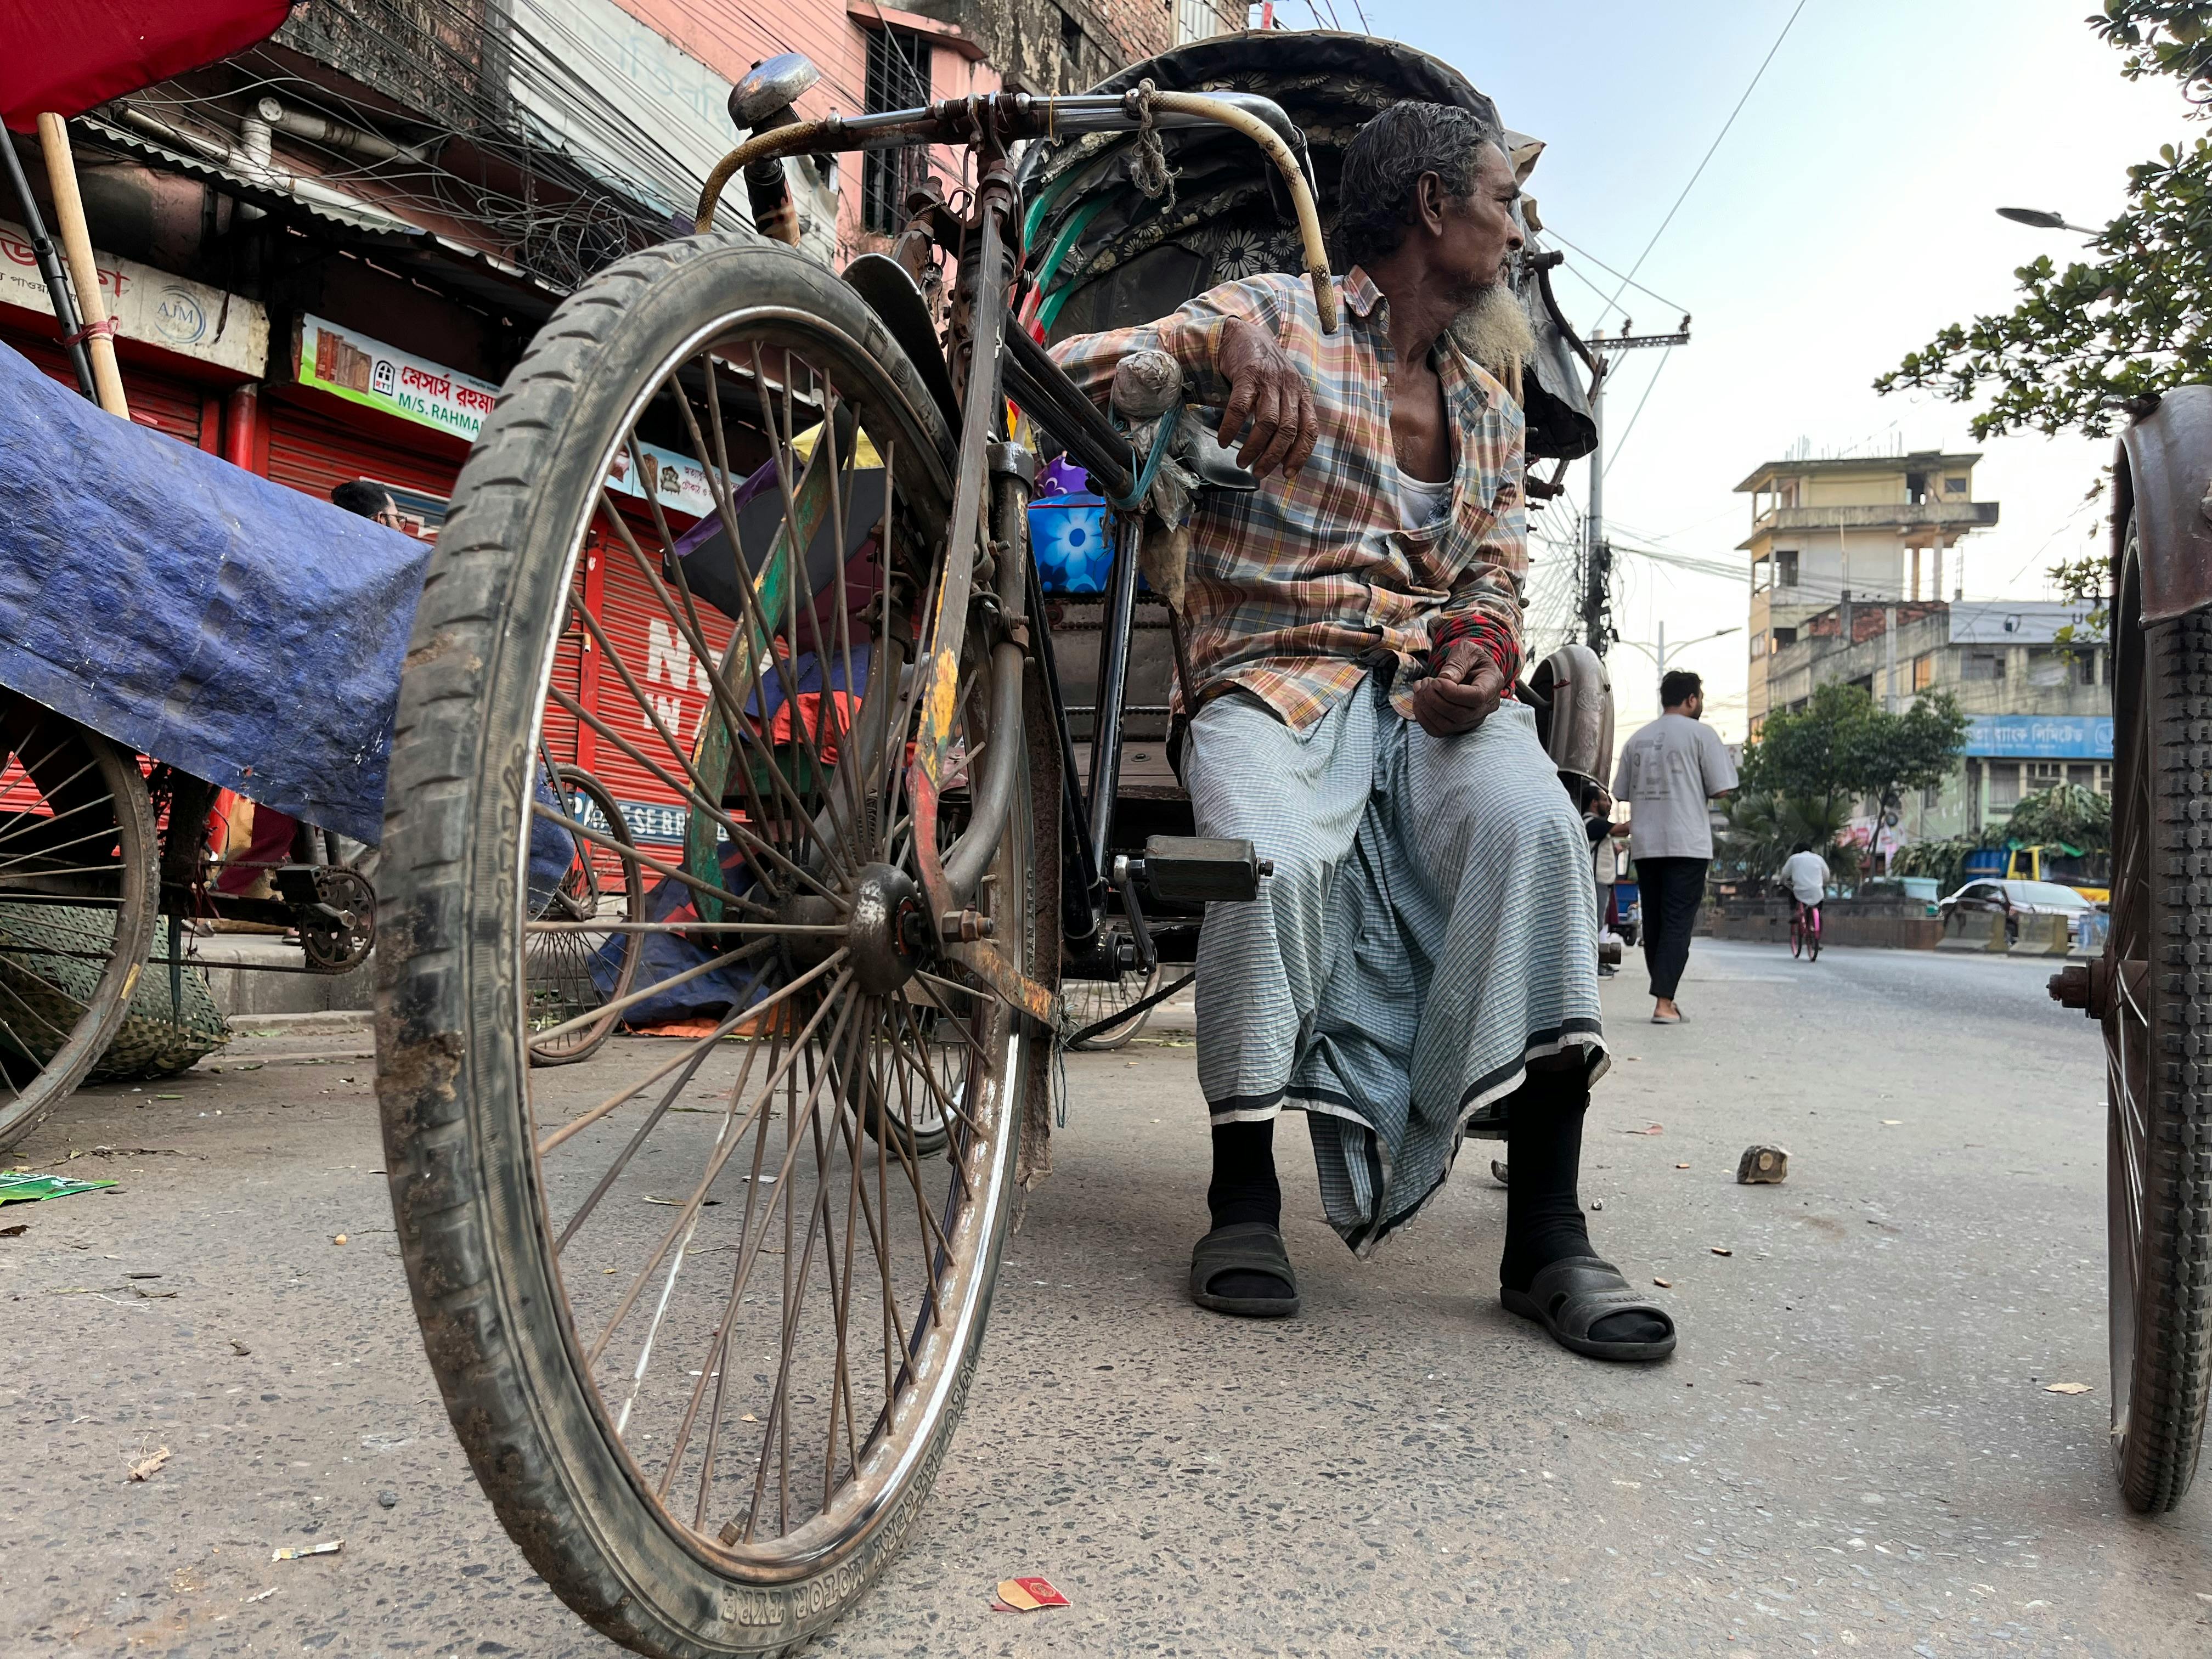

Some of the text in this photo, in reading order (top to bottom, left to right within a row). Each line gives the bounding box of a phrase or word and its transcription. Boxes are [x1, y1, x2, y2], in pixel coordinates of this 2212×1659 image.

[157, 301, 193, 323] AJM
[402, 366, 452, 400] মেসার্স
[456, 384, 495, 414] রহমা
[399, 393, 483, 433] M/S. RAHMA
[721, 1584, 785, 1627] TYRE
[793, 1555, 866, 1620] MOTOR
